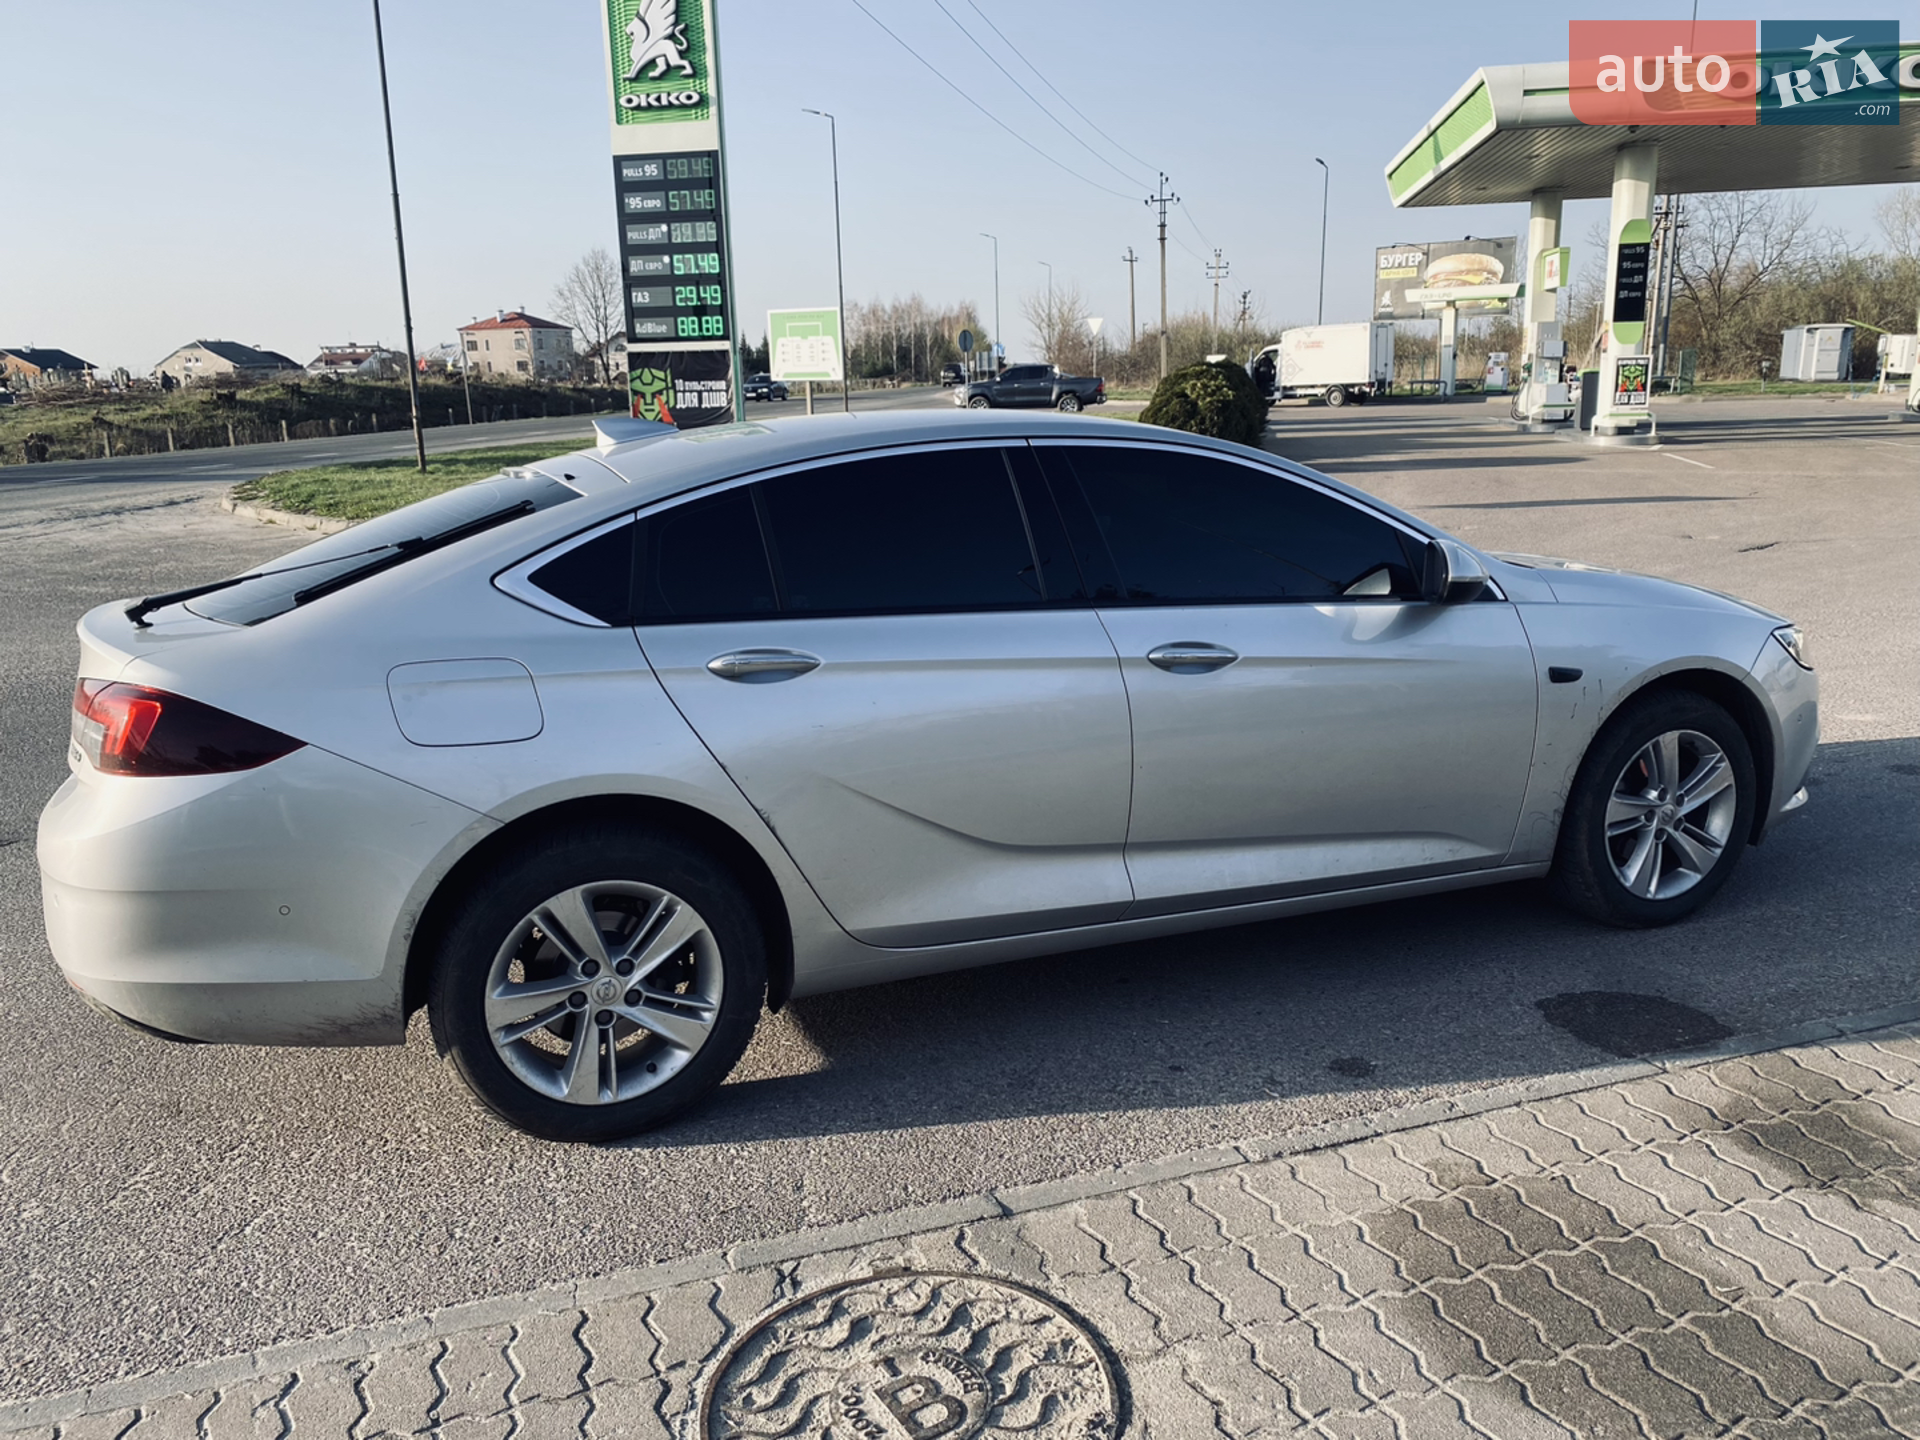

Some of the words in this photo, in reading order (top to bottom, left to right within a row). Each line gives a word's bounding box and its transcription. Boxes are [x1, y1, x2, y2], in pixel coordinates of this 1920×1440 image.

[619, 91, 701, 109] OKKO
[623, 167, 643, 177] PULLS
[644, 163, 658, 177] 95
[668, 189, 716, 212] 57.49
[627, 231, 647, 240] PULLS
[672, 252, 720, 276] 57.49
[1380, 252, 1423, 269] БУРГЕР
[632, 291, 650, 304] ГАЗ
[675, 284, 722, 307] 29.49
[635, 322, 668, 334] AdBlue
[677, 315, 724, 337] 88.88
[676, 391, 699, 409] ДЛЯ
